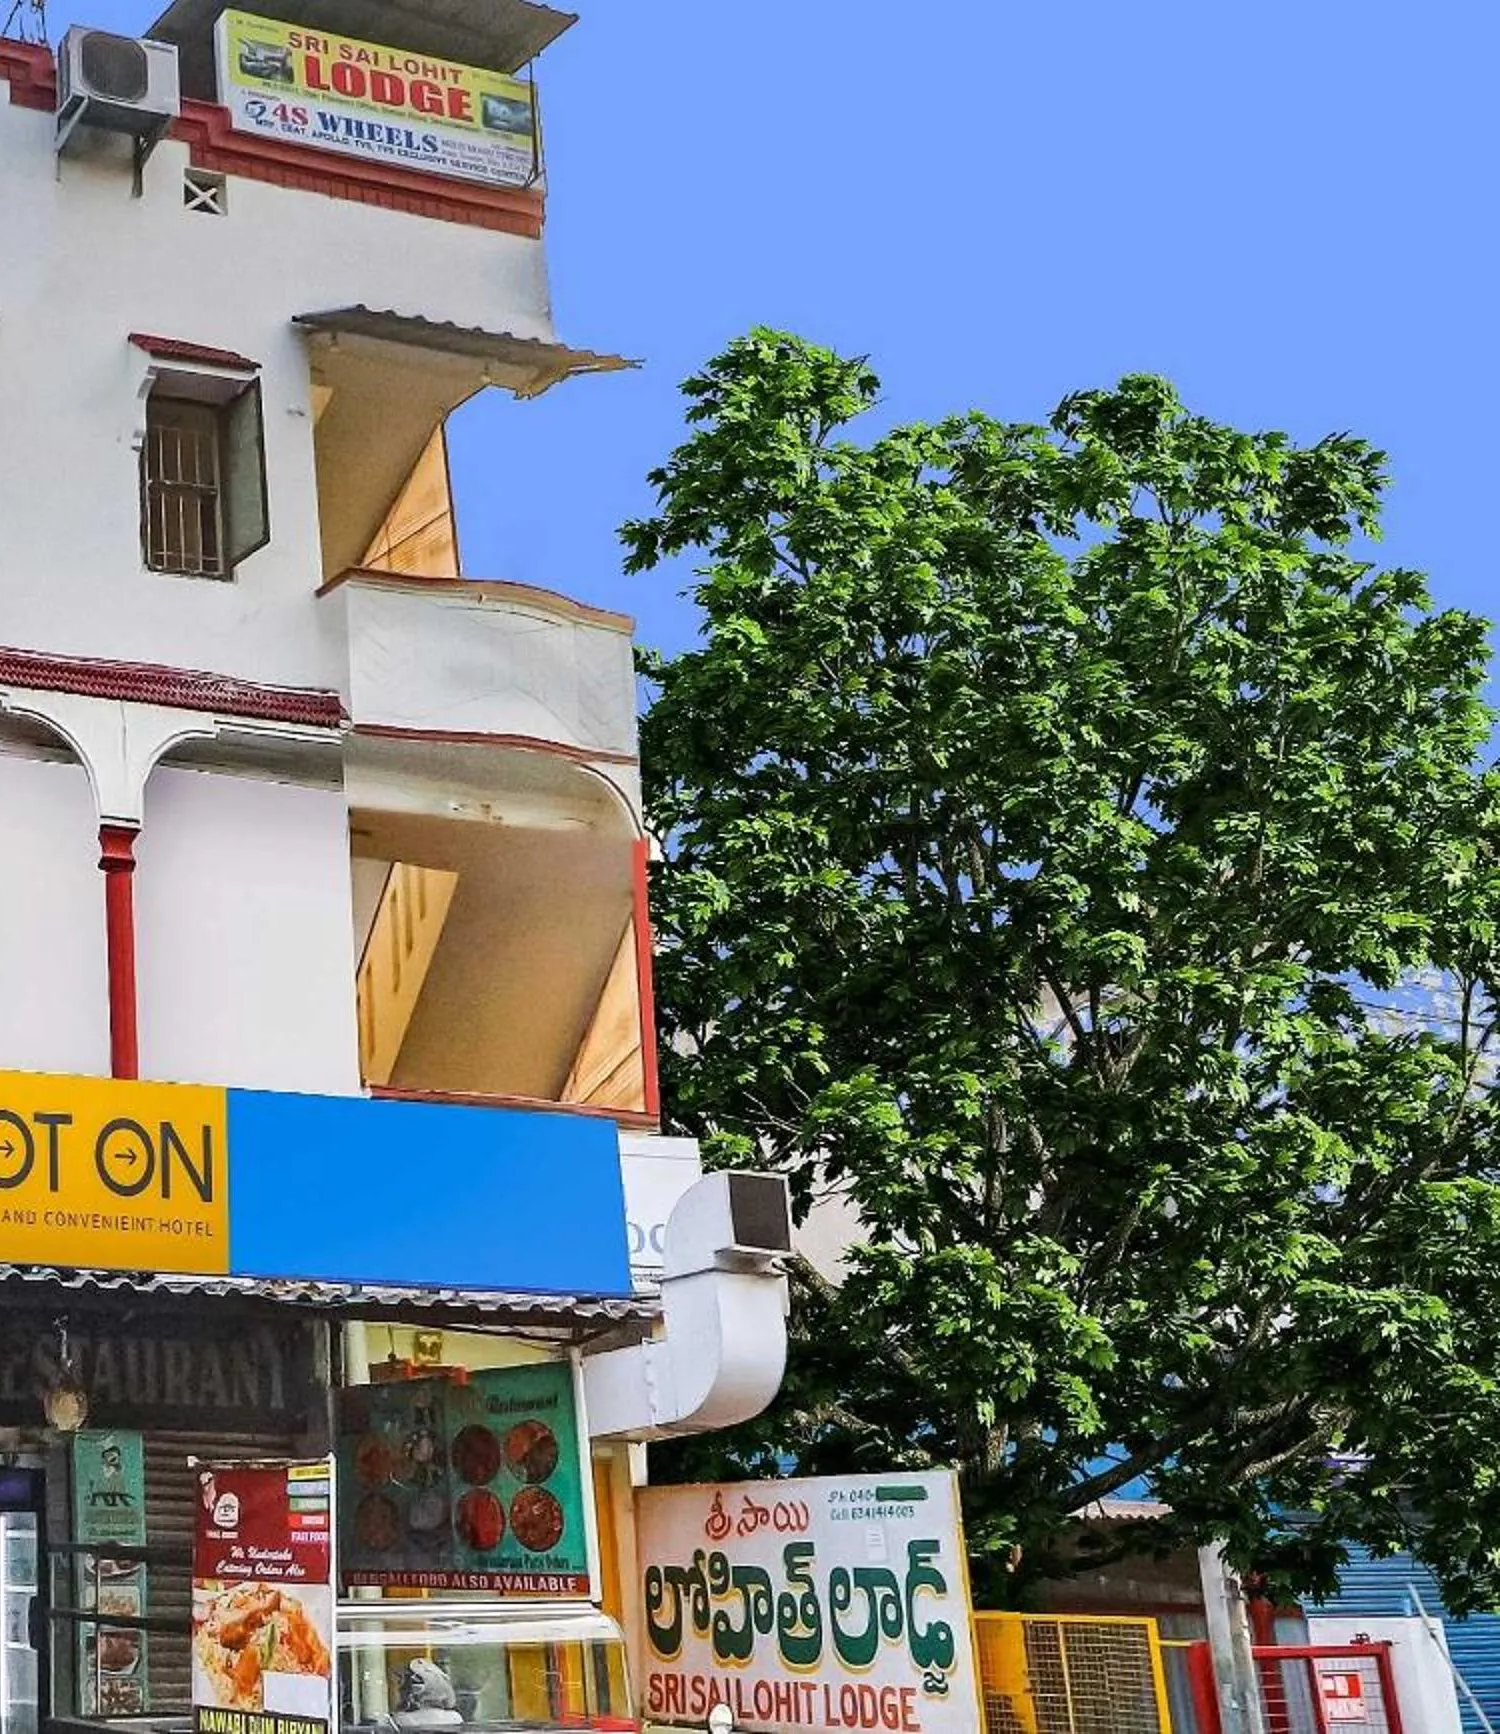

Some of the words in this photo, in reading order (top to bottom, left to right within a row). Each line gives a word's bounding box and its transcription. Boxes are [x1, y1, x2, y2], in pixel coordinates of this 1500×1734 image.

[288, 31, 329, 55] SRI
[339, 43, 380, 67] SAI
[389, 55, 464, 85] LOHIT
[304, 55, 476, 123] LODGE
[271, 102, 309, 127] 4S
[317, 110, 439, 153] WHEELS
[95, 1117, 214, 1203] ON
[0, 1208, 37, 1226] AND
[159, 1218, 214, 1238] HOTEL
[704, 1490, 731, 1541] శ్రీ
[736, 1495, 810, 1539] సాయి
[450, 1575, 490, 1590] ALSO
[491, 1576, 578, 1593] AVAILABLE
[649, 1673, 687, 1715] SRI
[690, 1675, 737, 1717] SAI
[737, 1679, 818, 1725] LOHIT
[825, 1683, 922, 1733] LODGE
